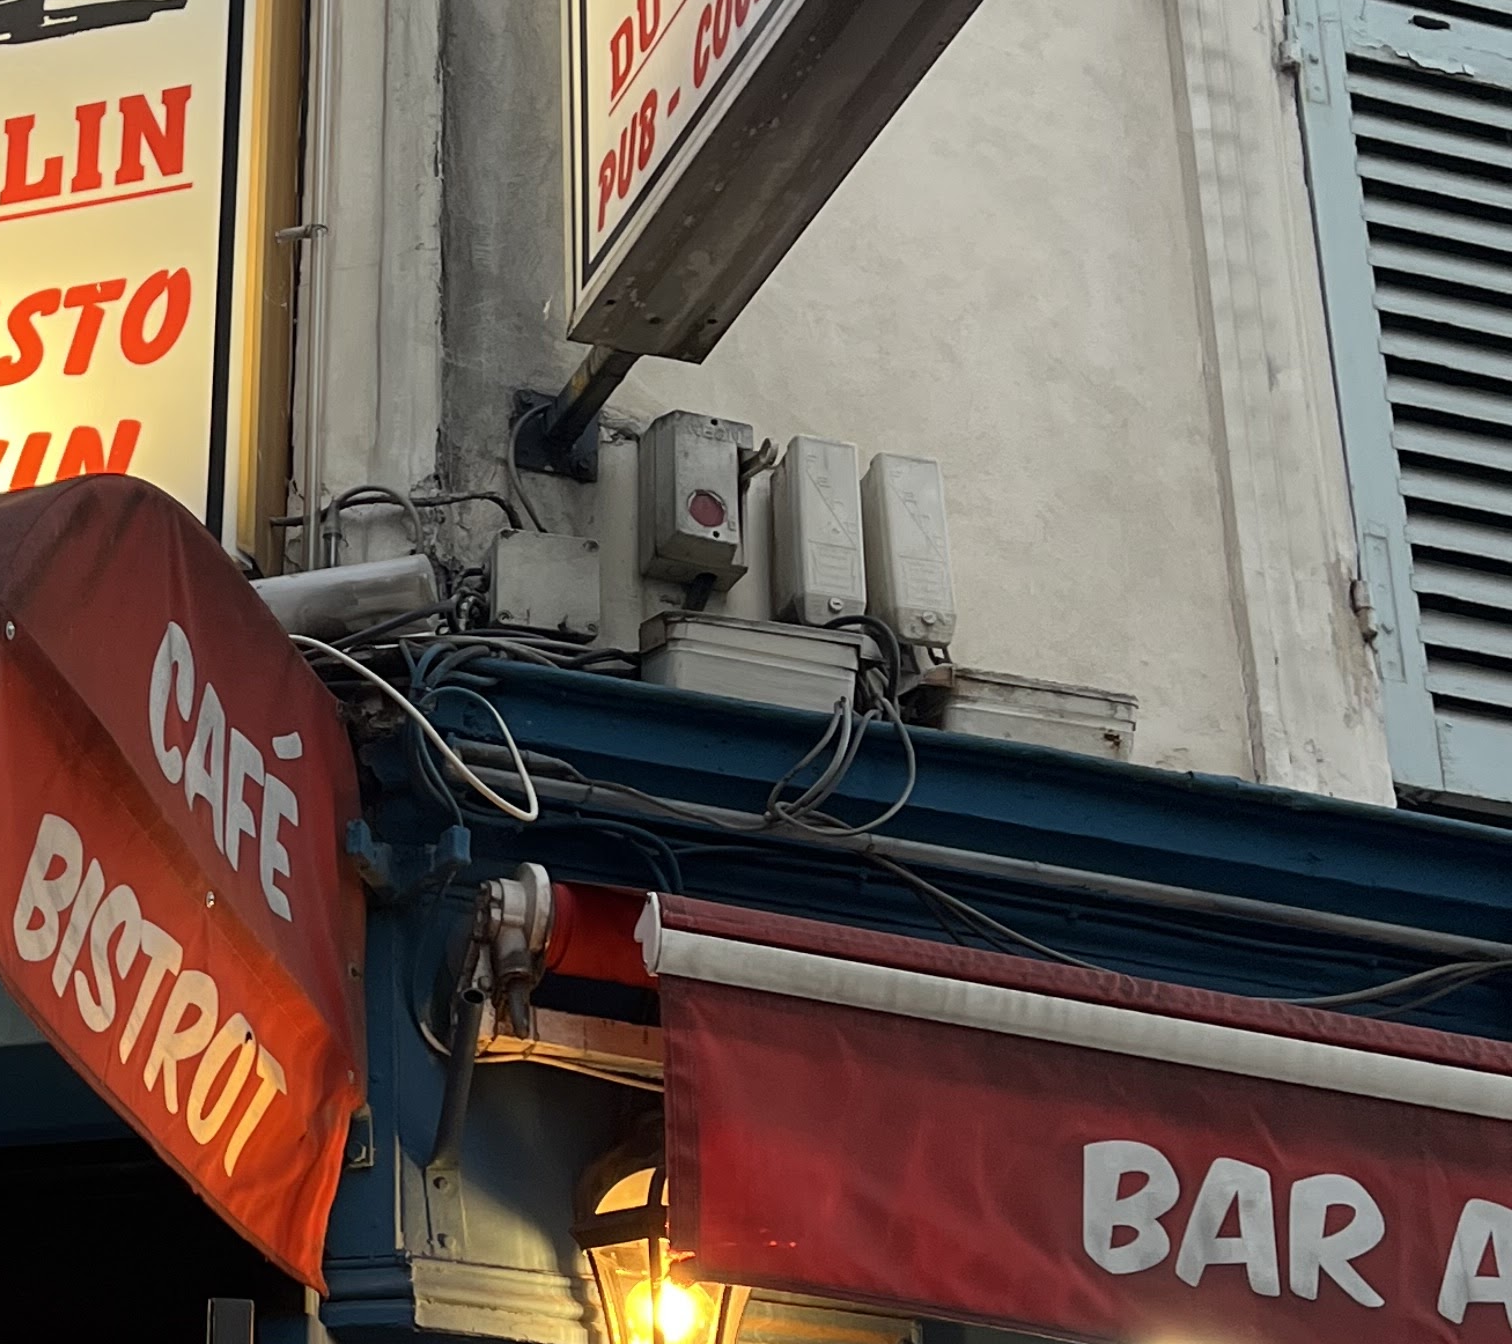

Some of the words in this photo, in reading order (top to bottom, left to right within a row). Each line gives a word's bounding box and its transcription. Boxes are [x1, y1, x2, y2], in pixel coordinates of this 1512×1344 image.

[597, 88, 659, 233] PUB
[147, 620, 303, 923] CAFÉ
[11, 812, 289, 1178] BISTROT
[1082, 1138, 1386, 1310] BAR
